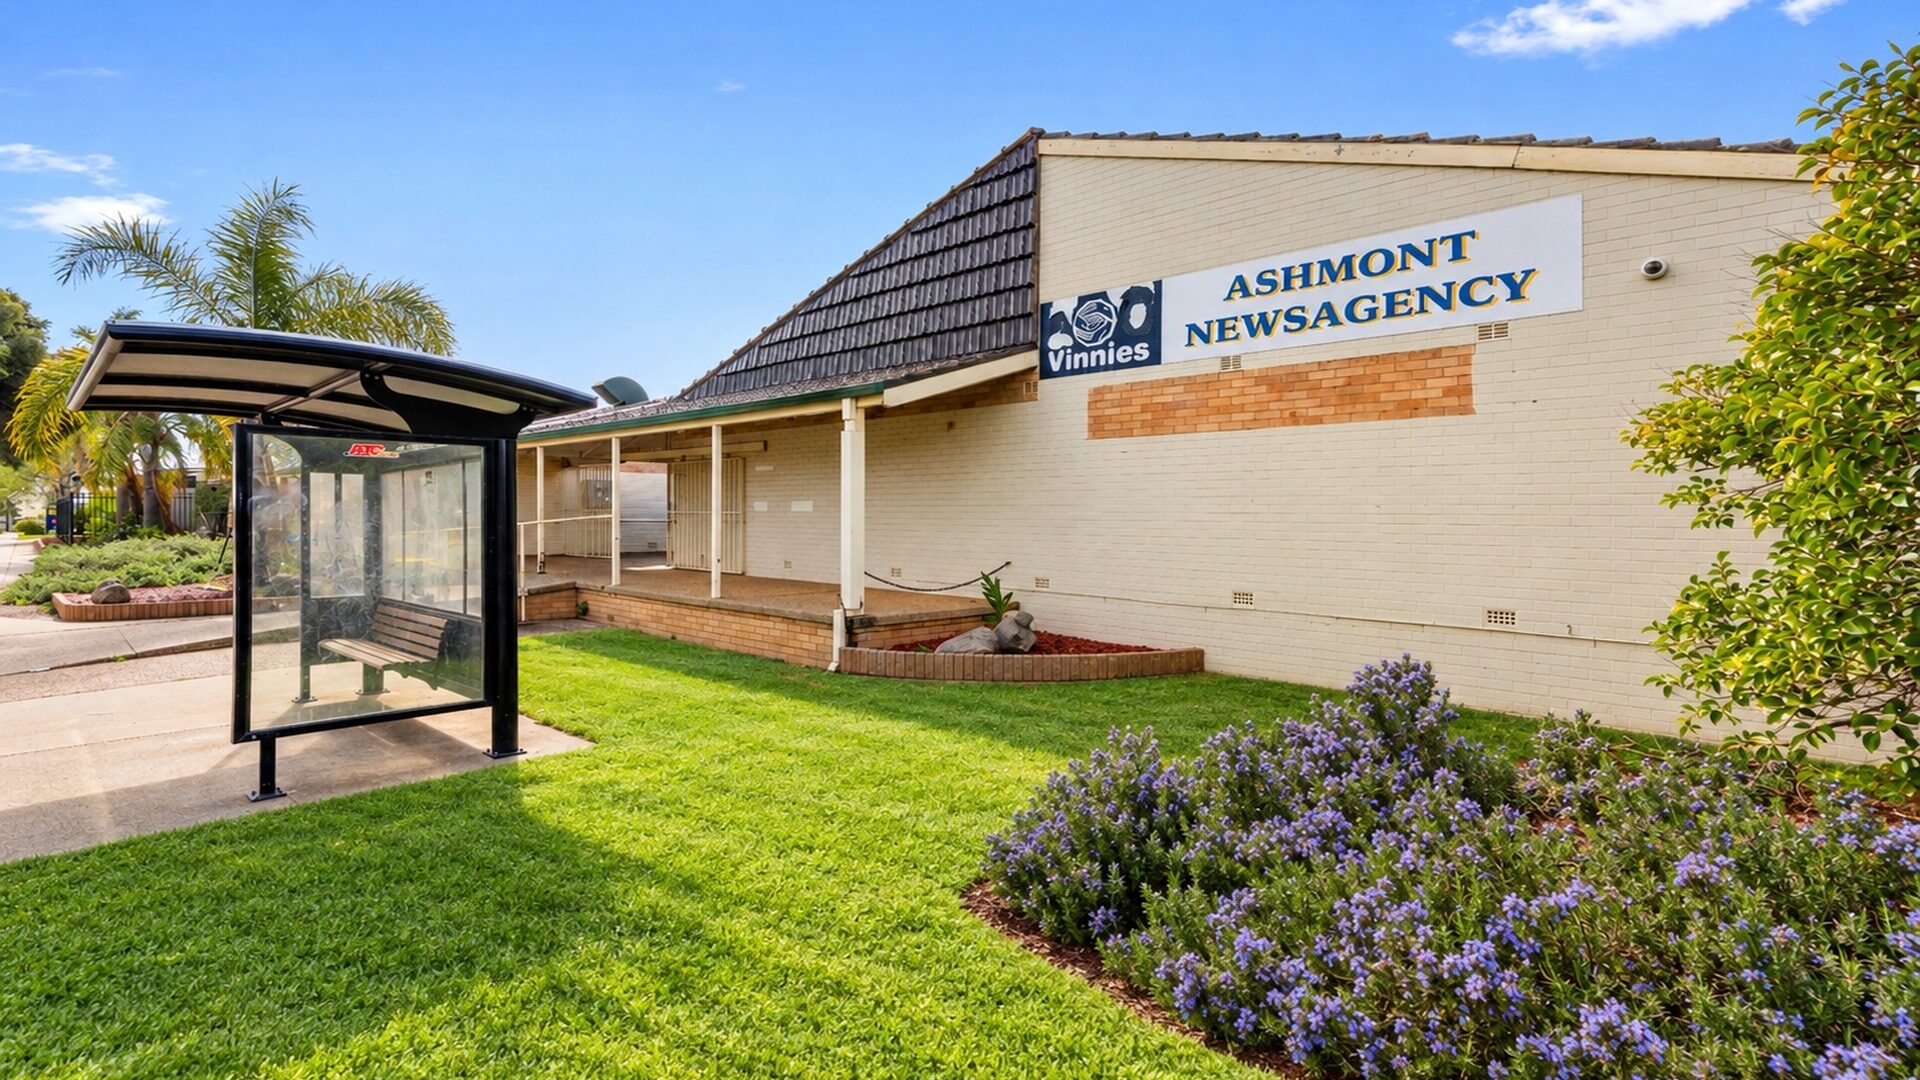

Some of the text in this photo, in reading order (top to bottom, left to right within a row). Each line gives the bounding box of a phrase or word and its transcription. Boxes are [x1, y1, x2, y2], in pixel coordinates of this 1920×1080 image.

[1222, 230, 1480, 303] ASHMONT
[1184, 268, 1538, 349] NEWSAGENCY
[1048, 340, 1150, 372] Vinnies
